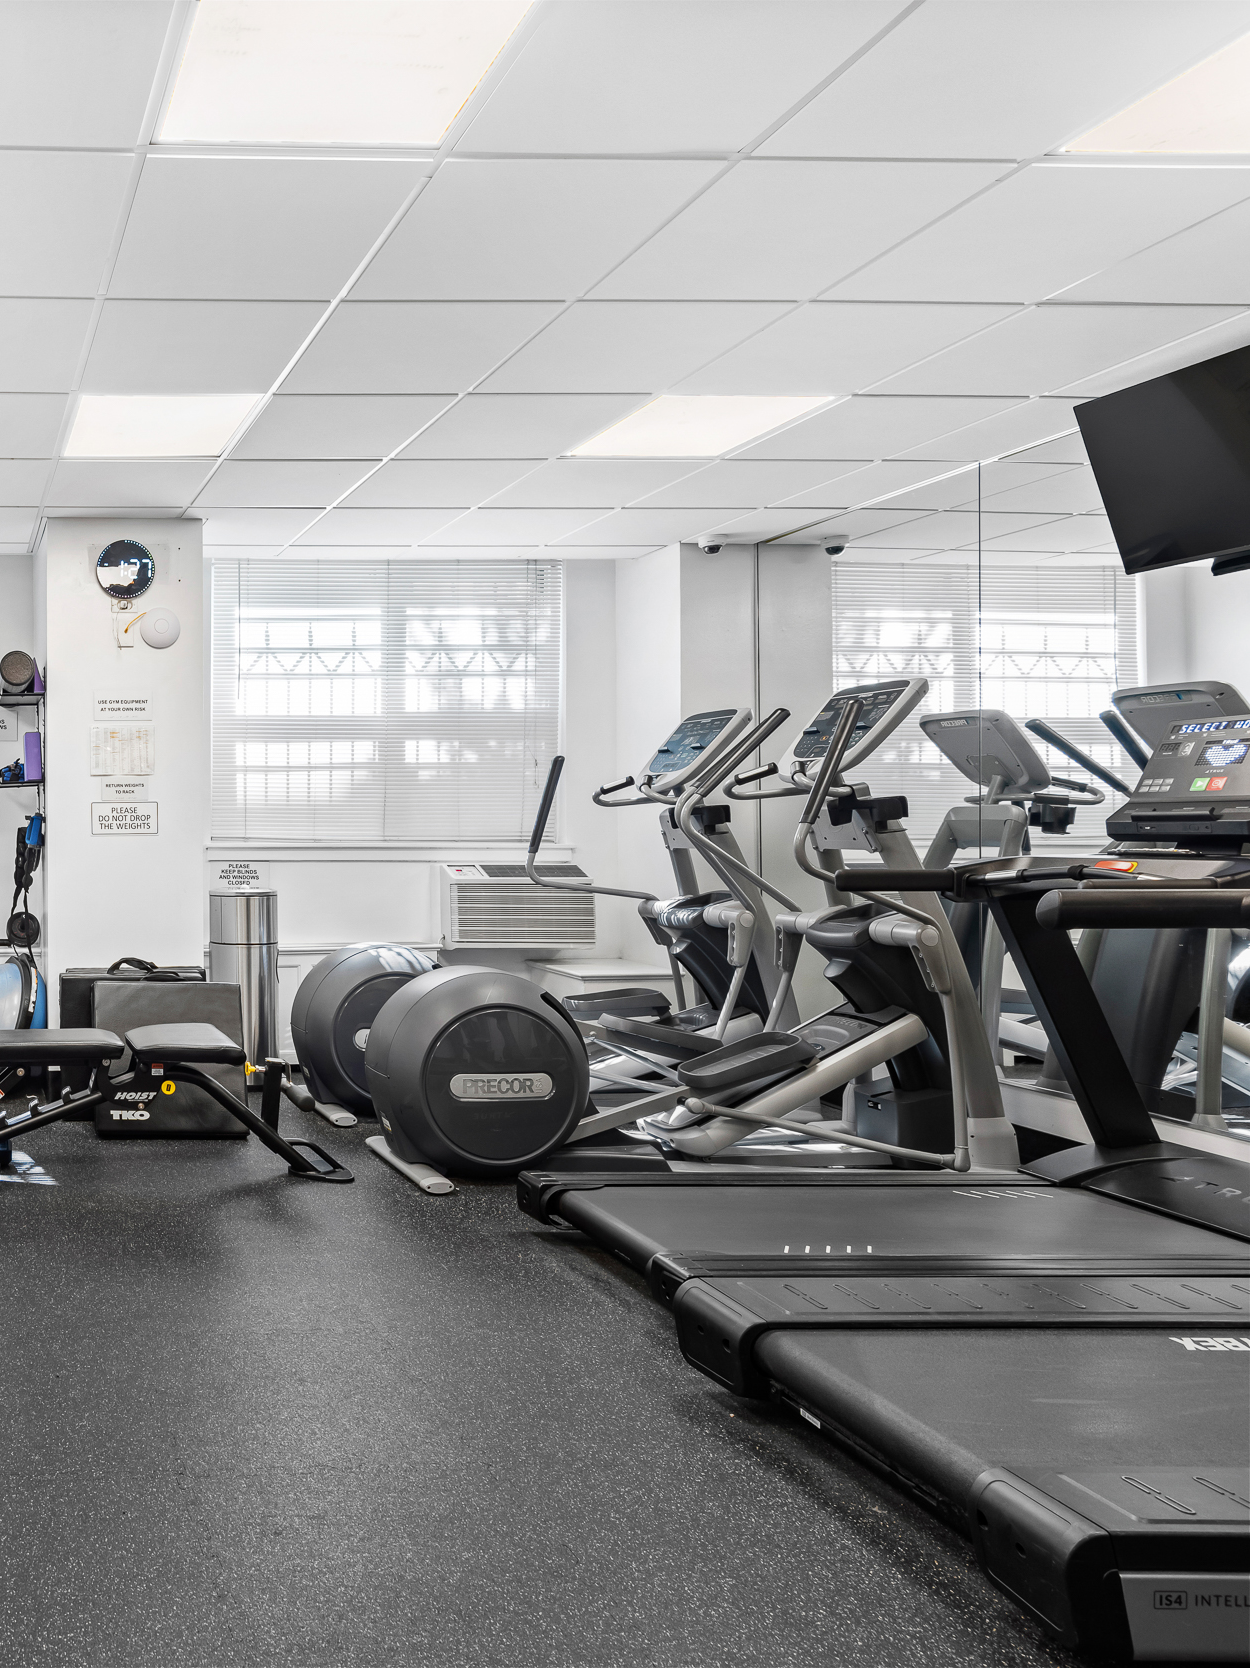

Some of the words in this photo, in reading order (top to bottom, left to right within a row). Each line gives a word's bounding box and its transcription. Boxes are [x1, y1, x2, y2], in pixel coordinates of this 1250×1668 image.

[1179, 722, 1228, 734] SELECT
[462, 1078, 535, 1094] PRECOR
[114, 1092, 157, 1100] HOIST
[110, 1110, 150, 1120] TKO
[1159, 1594, 1183, 1606] IS4
[1195, 1594, 1250, 1607] INTELL
